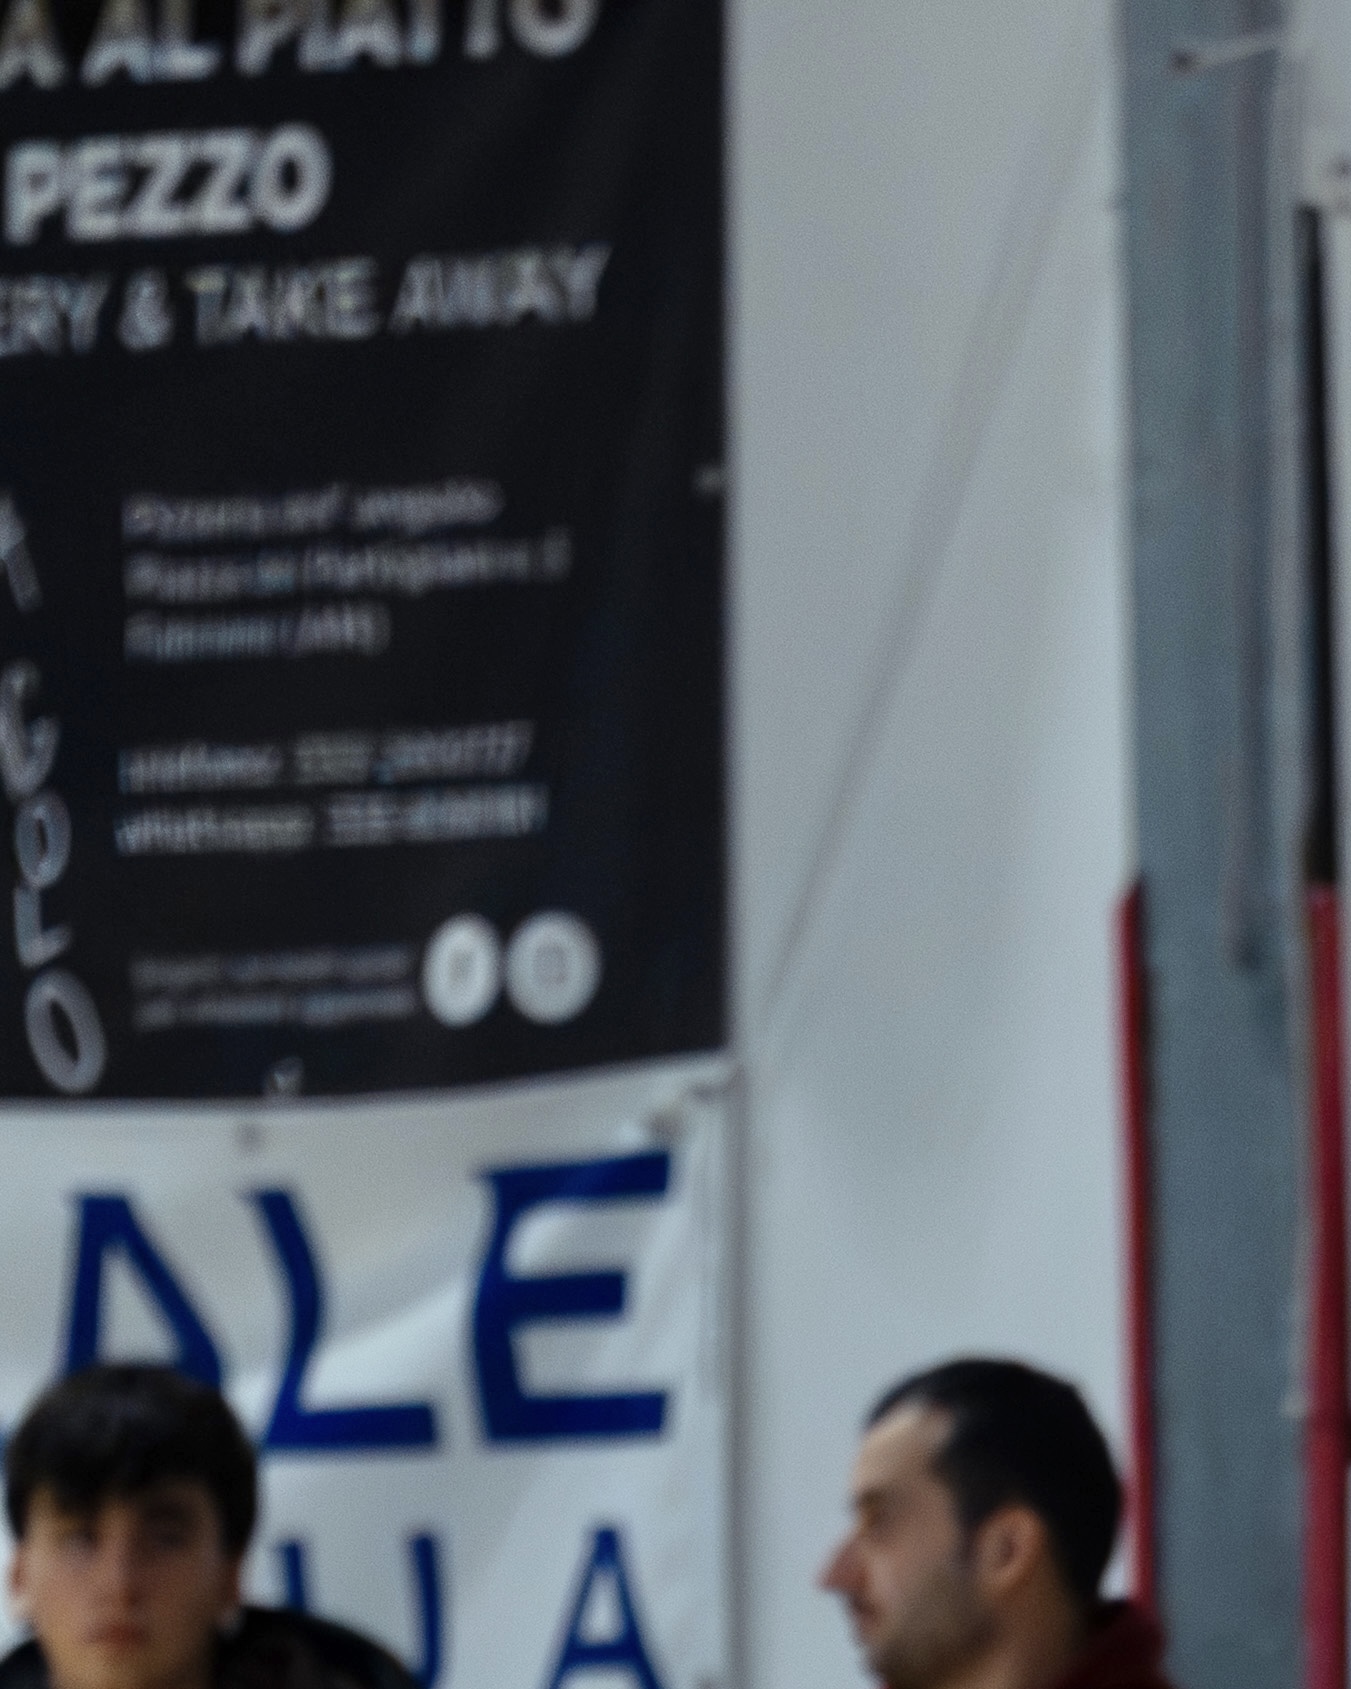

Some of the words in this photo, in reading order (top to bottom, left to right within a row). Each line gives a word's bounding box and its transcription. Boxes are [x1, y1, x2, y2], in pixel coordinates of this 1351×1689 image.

[5, 122, 333, 245] PEZZO
[118, 268, 172, 352] &
[187, 257, 380, 345] TAKE
